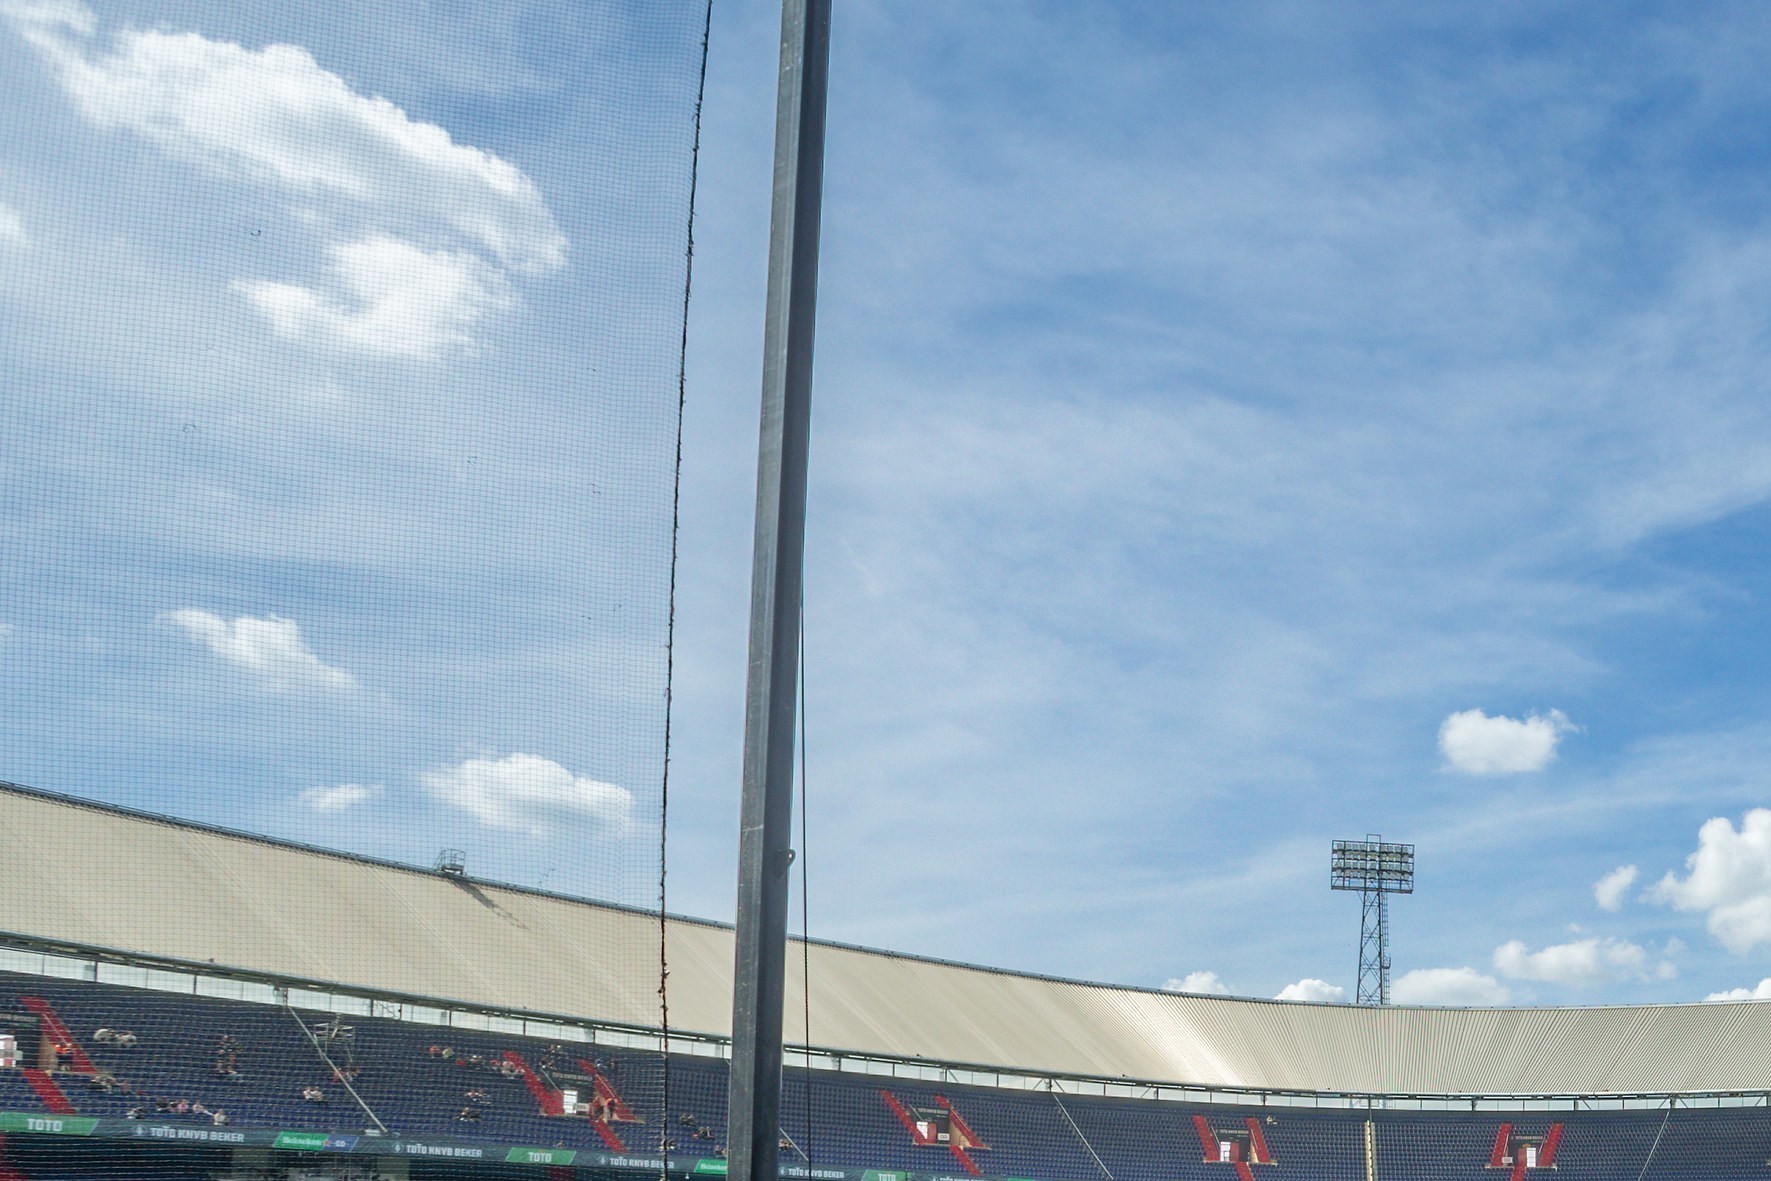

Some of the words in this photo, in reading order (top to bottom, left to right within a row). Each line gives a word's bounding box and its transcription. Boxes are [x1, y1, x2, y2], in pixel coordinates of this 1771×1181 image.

[27, 1118, 62, 1132] TOTO
[151, 1127, 176, 1139] TOTO
[178, 1129, 207, 1141] KNVB
[210, 1131, 244, 1143] BEKER
[528, 1152, 552, 1162] TOTO
[878, 1174, 896, 1181] TOTO
